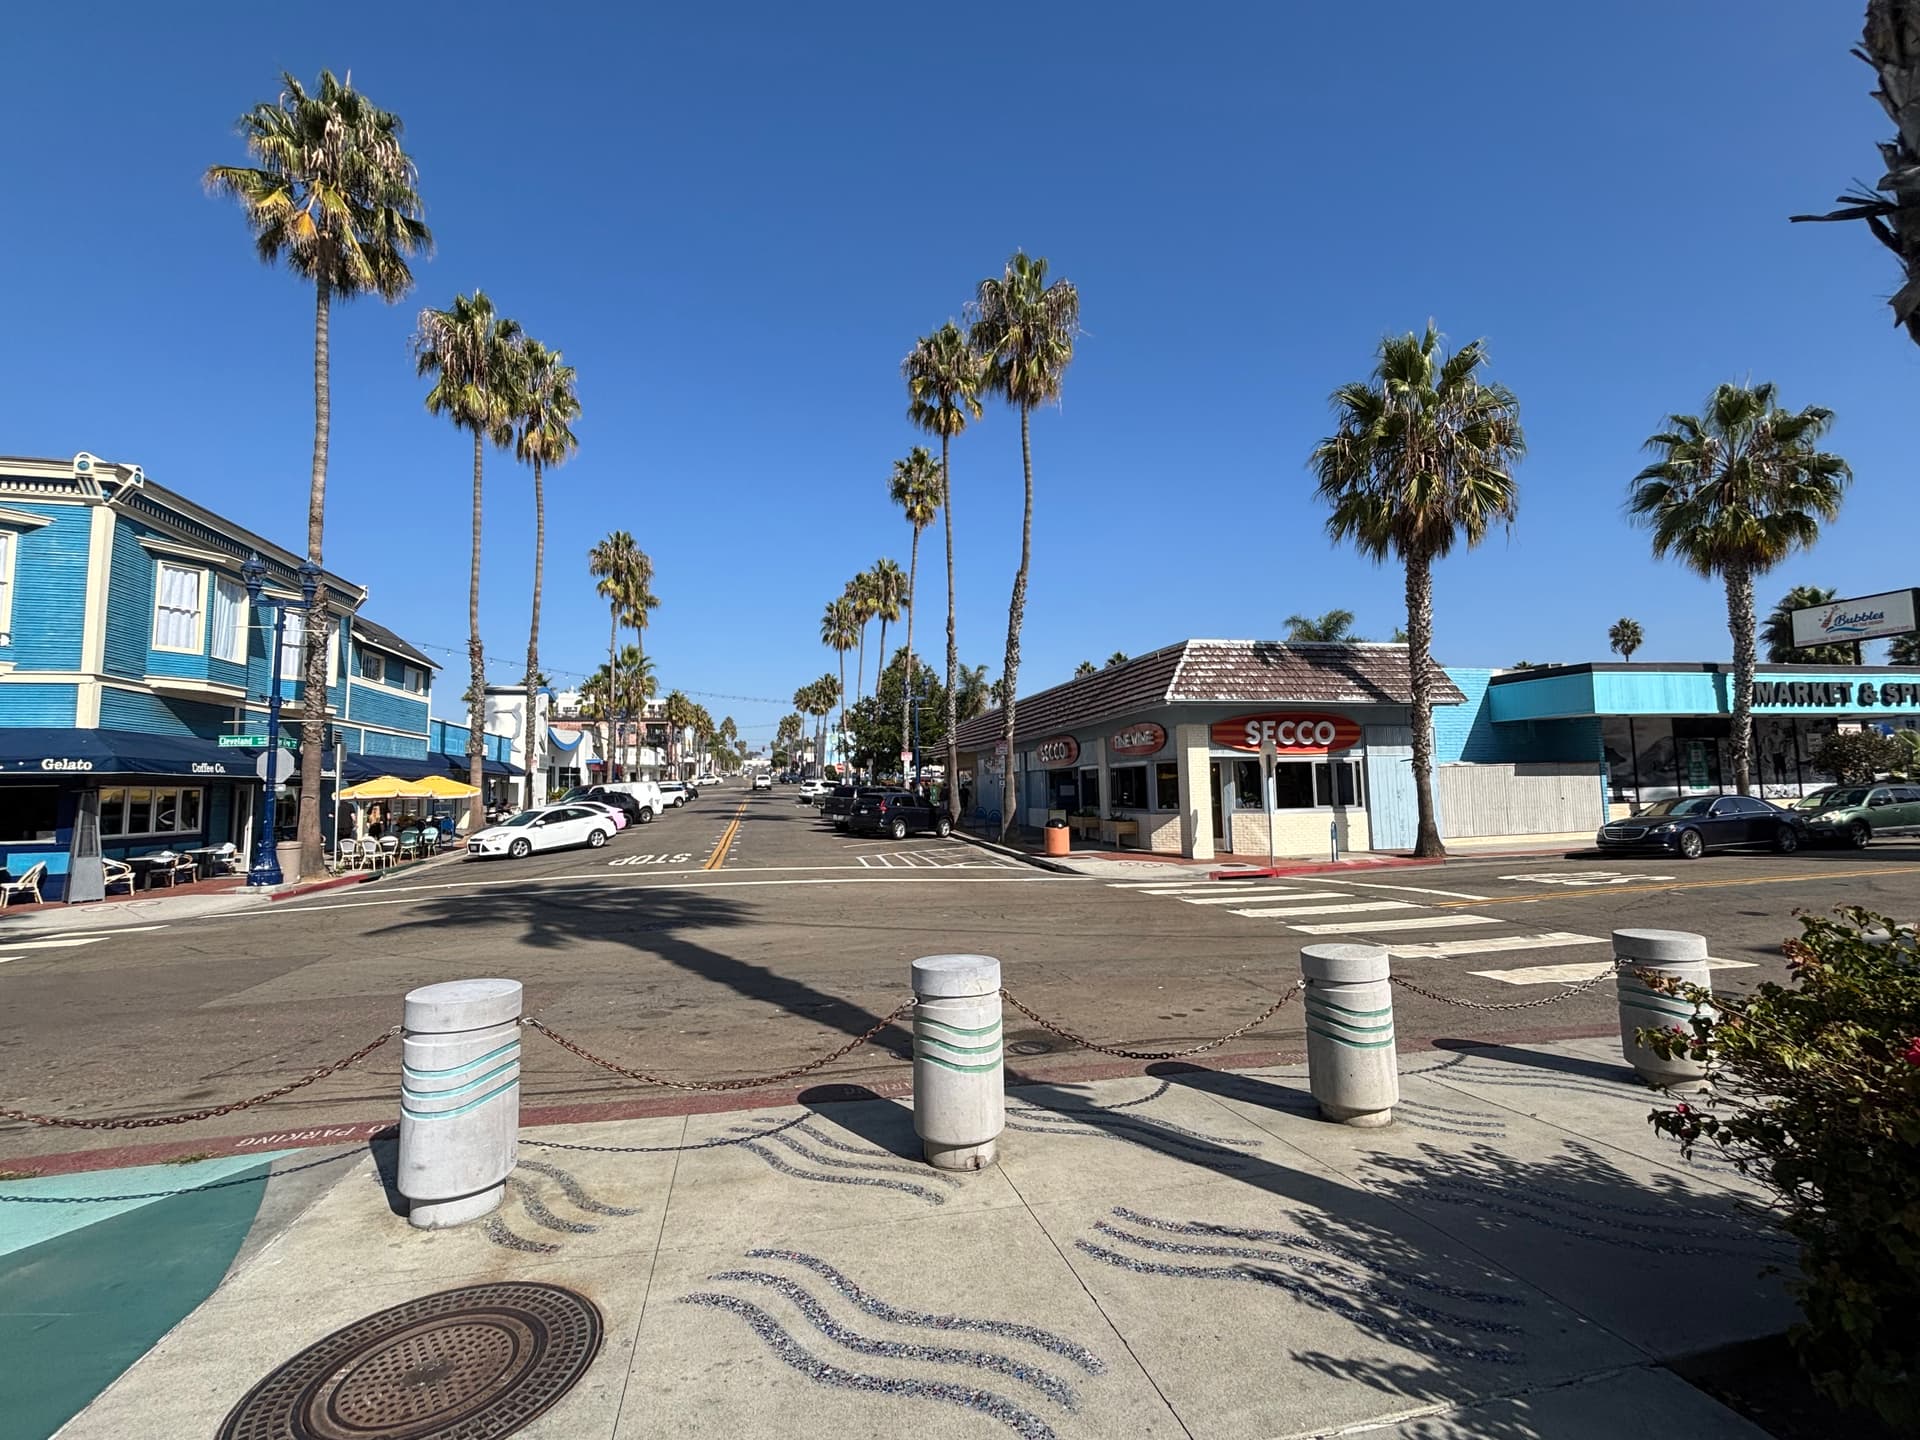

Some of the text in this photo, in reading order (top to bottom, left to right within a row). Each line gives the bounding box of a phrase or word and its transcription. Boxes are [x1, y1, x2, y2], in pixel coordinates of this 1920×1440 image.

[1834, 611, 1885, 627] Bubbles
[1753, 682, 1853, 706] MARKET
[1859, 683, 1879, 706] &
[219, 737, 253, 745] Cleveland
[1245, 720, 1336, 746] SECCO
[1040, 742, 1066, 762] SECCO
[41, 758, 93, 771] Gelato
[192, 762, 226, 774] Coffee Co.
[607, 852, 692, 866] STOP
[236, 1126, 357, 1147] PARKING
